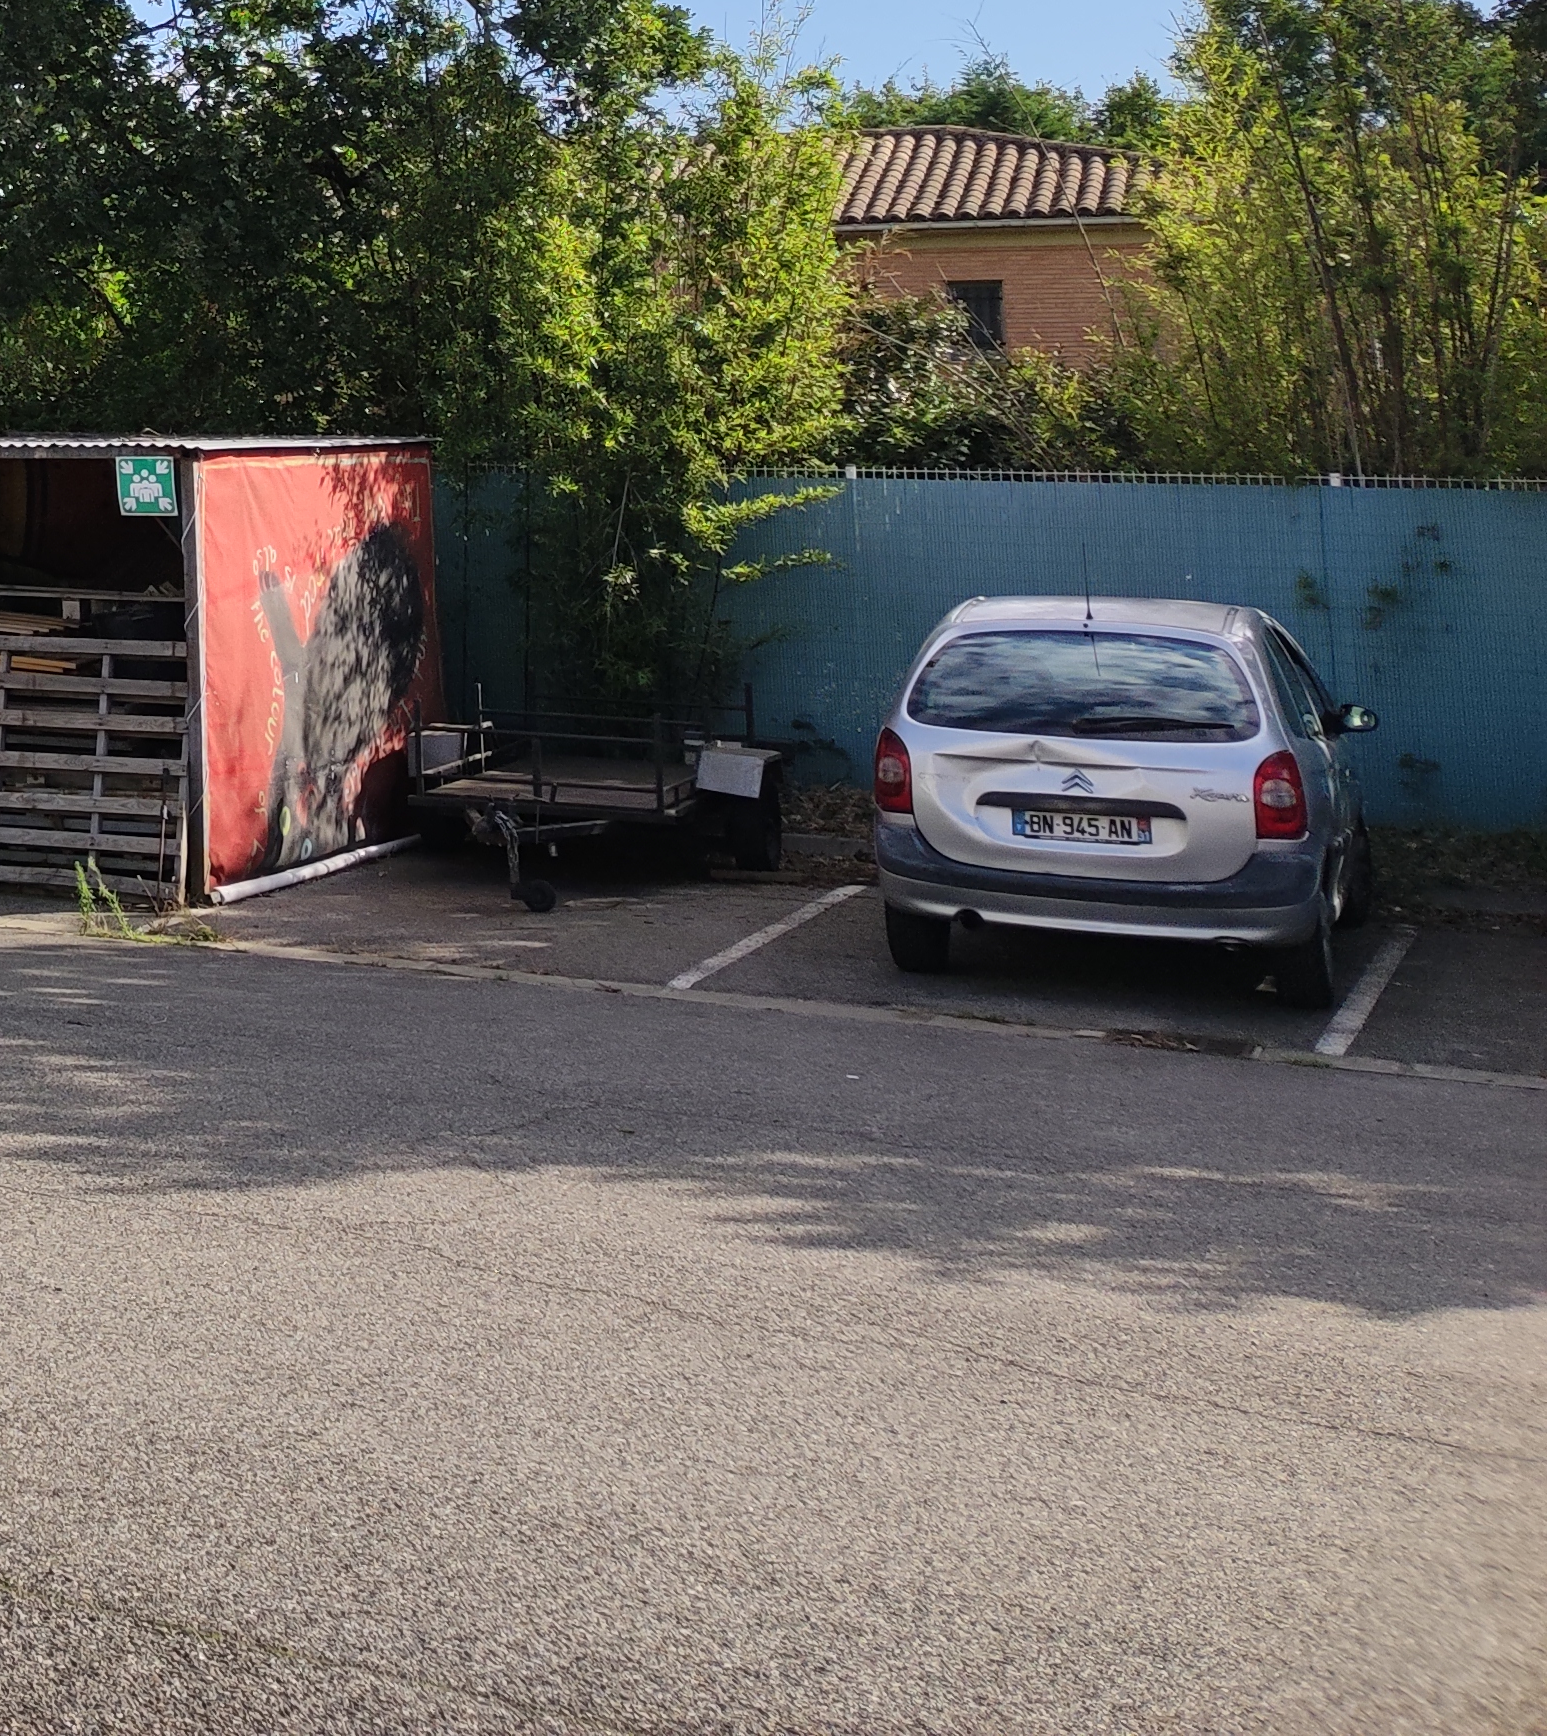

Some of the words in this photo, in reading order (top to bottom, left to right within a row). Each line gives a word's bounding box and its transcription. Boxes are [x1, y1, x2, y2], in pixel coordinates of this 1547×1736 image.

[252, 544, 277, 576] also
[264, 650, 285, 756] colour
[1029, 814, 1133, 839] BN-945-AN
